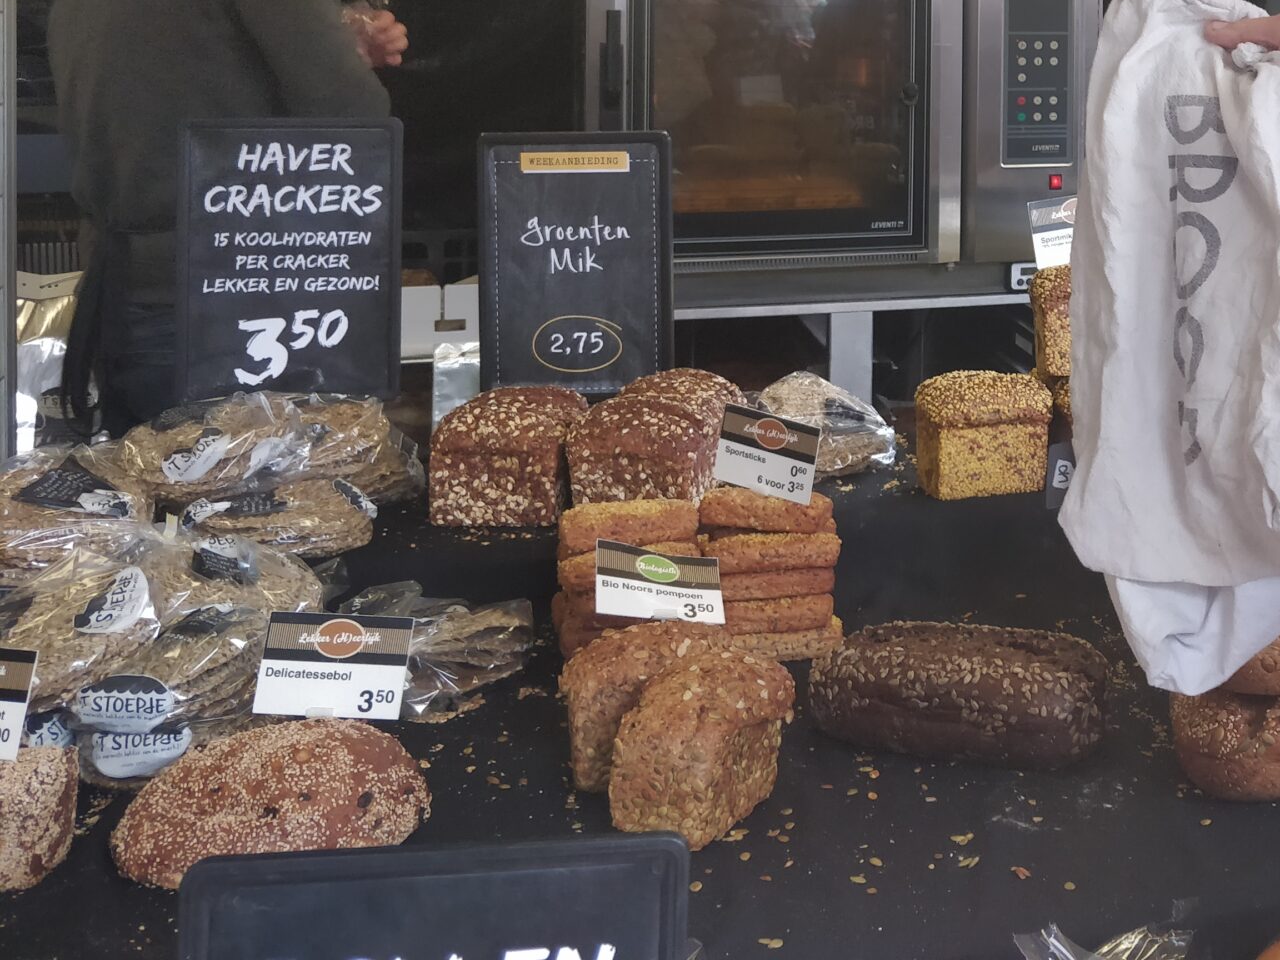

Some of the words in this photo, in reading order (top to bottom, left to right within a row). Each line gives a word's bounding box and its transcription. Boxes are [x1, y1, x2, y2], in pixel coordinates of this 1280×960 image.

[237, 142, 355, 175] HAVER
[528, 156, 619, 166] WEEKAANBIEDING
[204, 183, 384, 217] CRACKERS
[213, 232, 230, 247] 15
[234, 231, 372, 247] KOOLHYDRATEN
[235, 255, 269, 270] PER
[273, 254, 350, 270] CRACKER
[550, 246, 603, 274] Mik
[202, 278, 270, 294] LEKKER
[275, 277, 299, 291] EN
[304, 275, 381, 291] GEZOND!
[550, 332, 604, 354] 2,75
[724, 445, 767, 464] Sportsticks
[765, 478, 786, 490] voor
[601, 579, 619, 589] Bio
[622, 582, 654, 593] Noors
[655, 588, 704, 600] pompoen
[265, 666, 352, 681] Delicatessebol
[91, 696, 167, 714] STOEPJE
